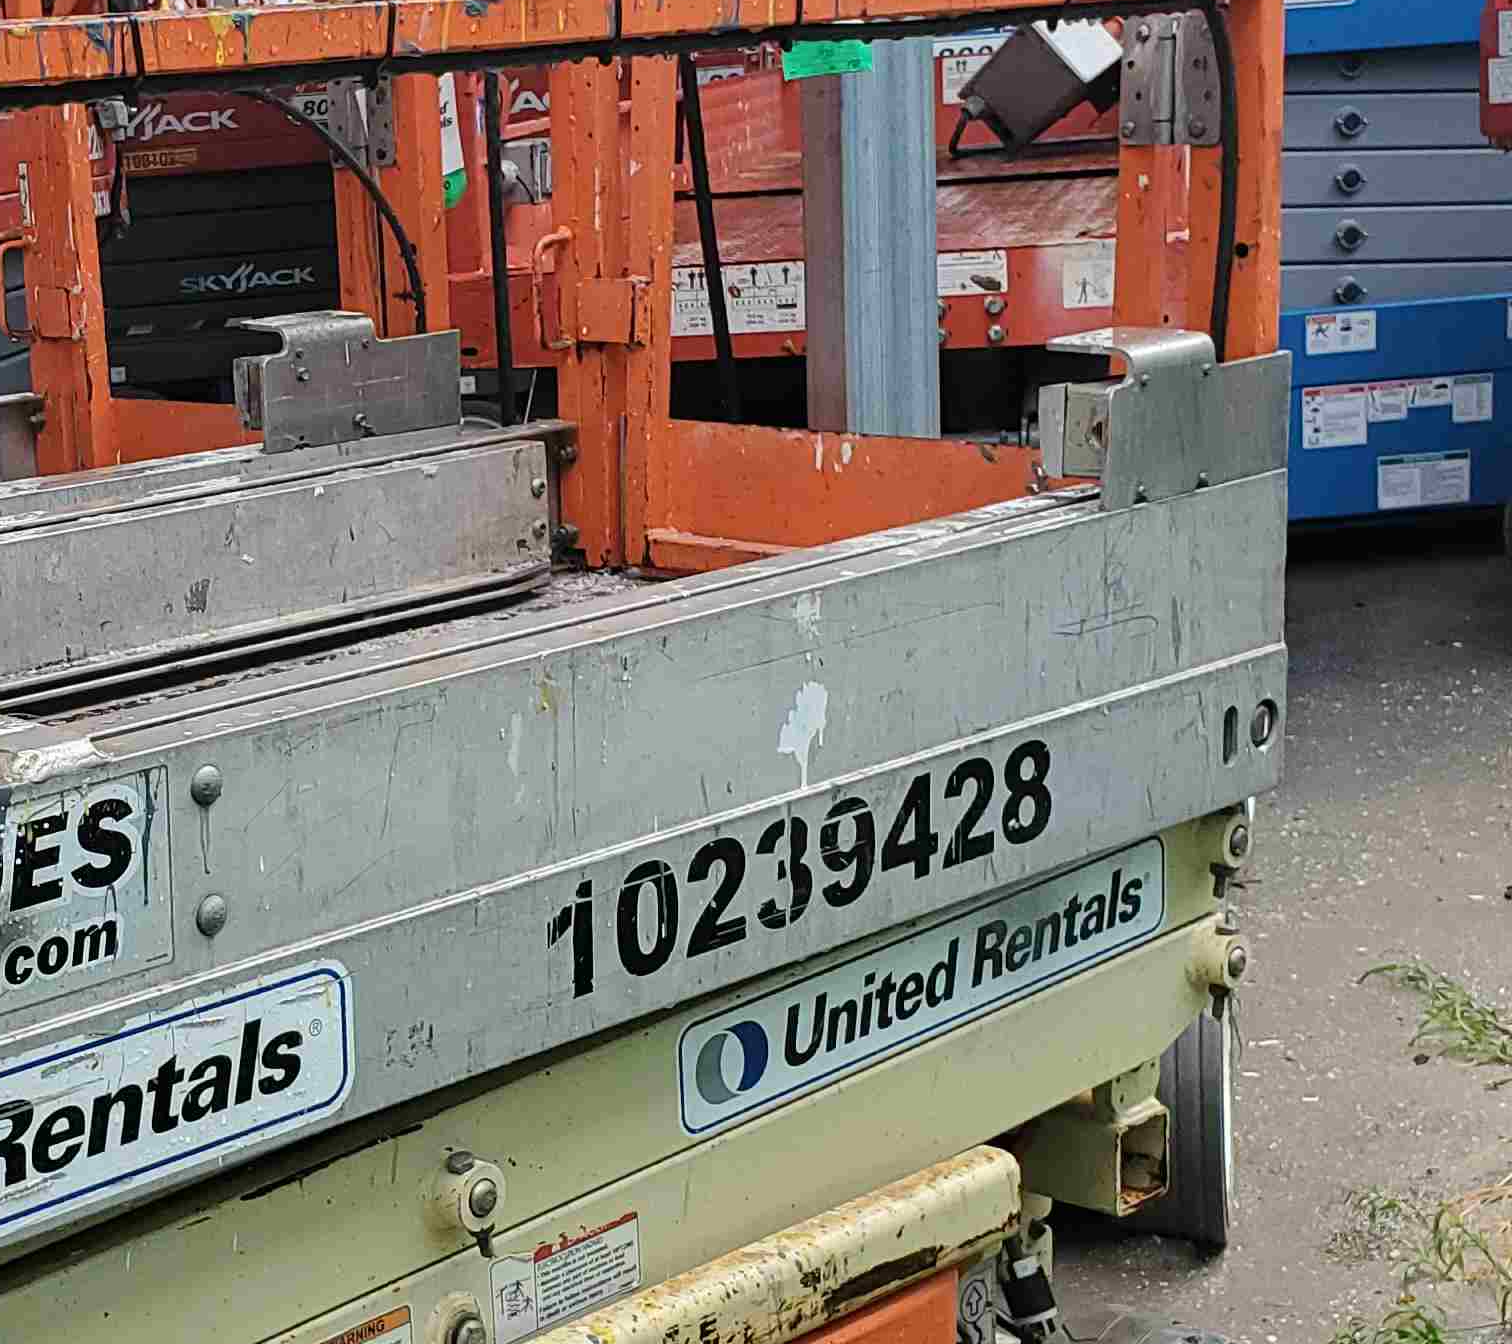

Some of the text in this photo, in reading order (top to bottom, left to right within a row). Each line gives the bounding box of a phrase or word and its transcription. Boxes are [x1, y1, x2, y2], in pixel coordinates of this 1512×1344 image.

[126, 103, 240, 141] YJACK
[179, 263, 315, 293] SKYJACK
[545, 739, 1053, 1000] 10239428
[782, 868, 1144, 1068] United Rentals
